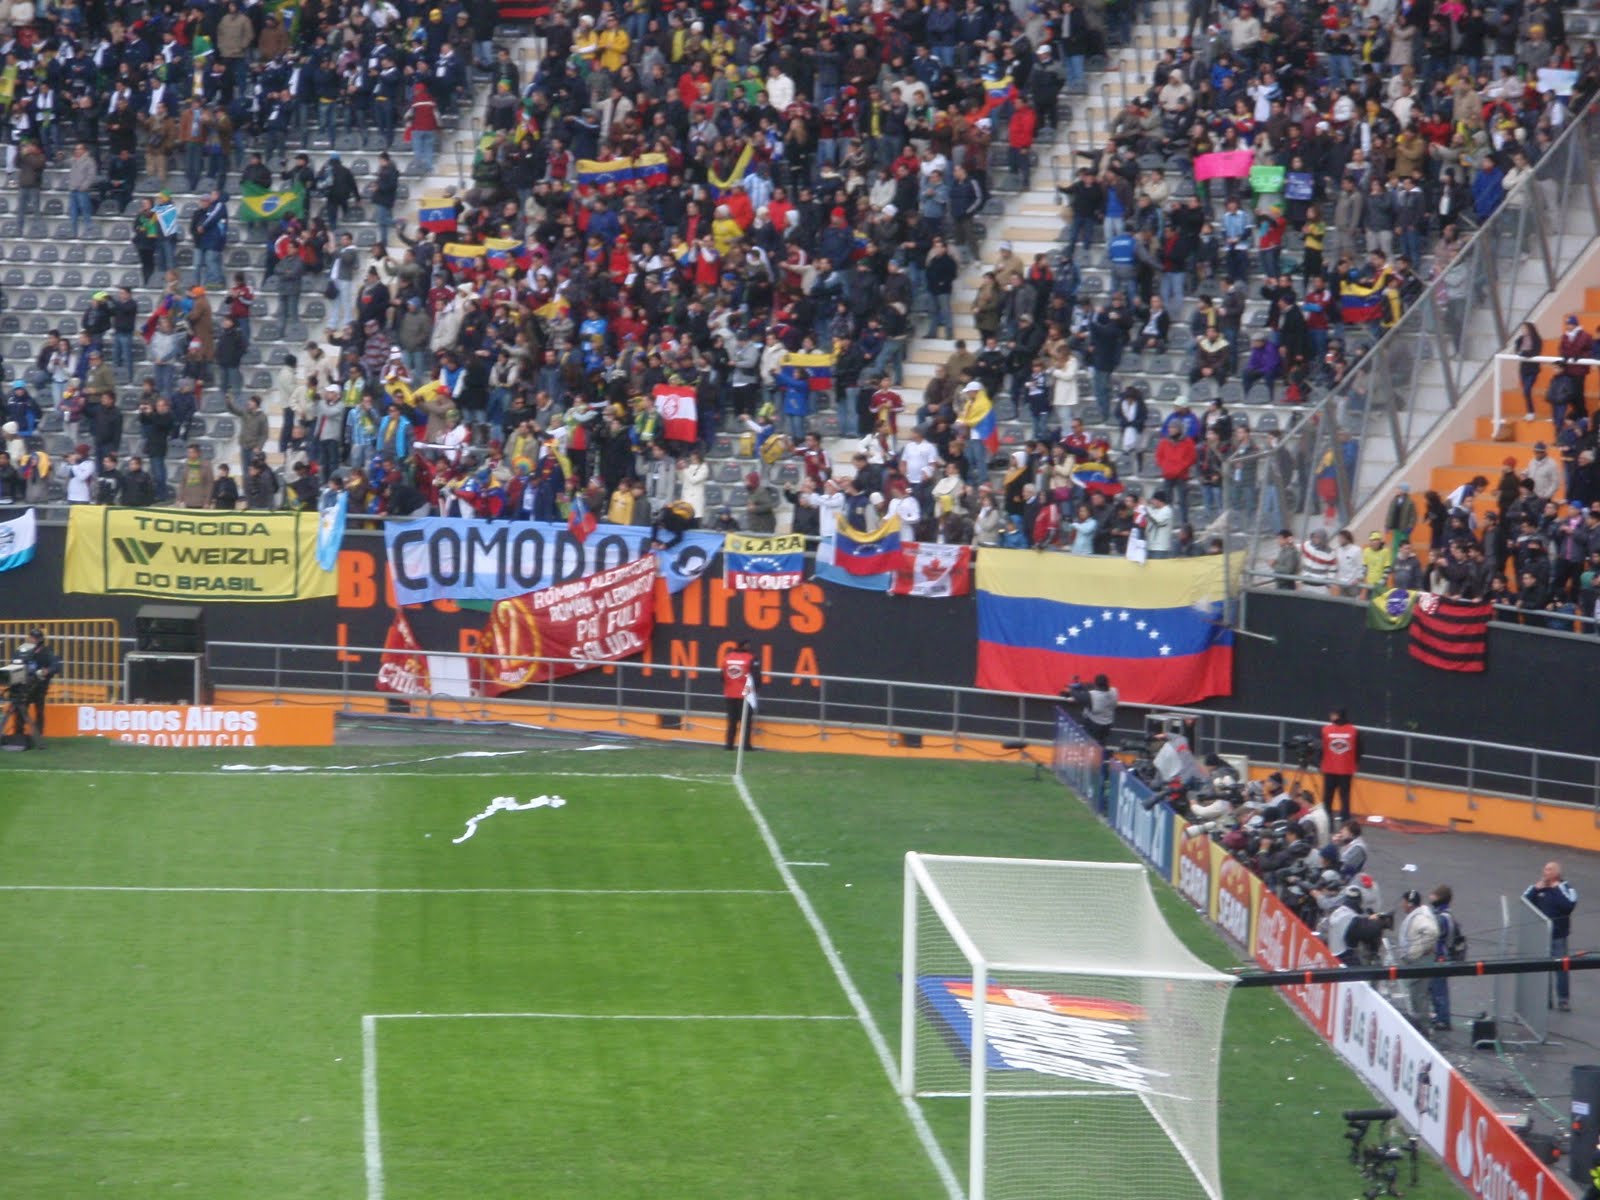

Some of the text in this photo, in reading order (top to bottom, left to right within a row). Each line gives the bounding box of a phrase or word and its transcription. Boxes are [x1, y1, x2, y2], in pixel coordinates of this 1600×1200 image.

[134, 516, 270, 537] TORCIDA
[172, 546, 289, 566] WEIZUR
[135, 572, 263, 592] DO BRASIL
[78, 706, 258, 731] Buenos Aires
